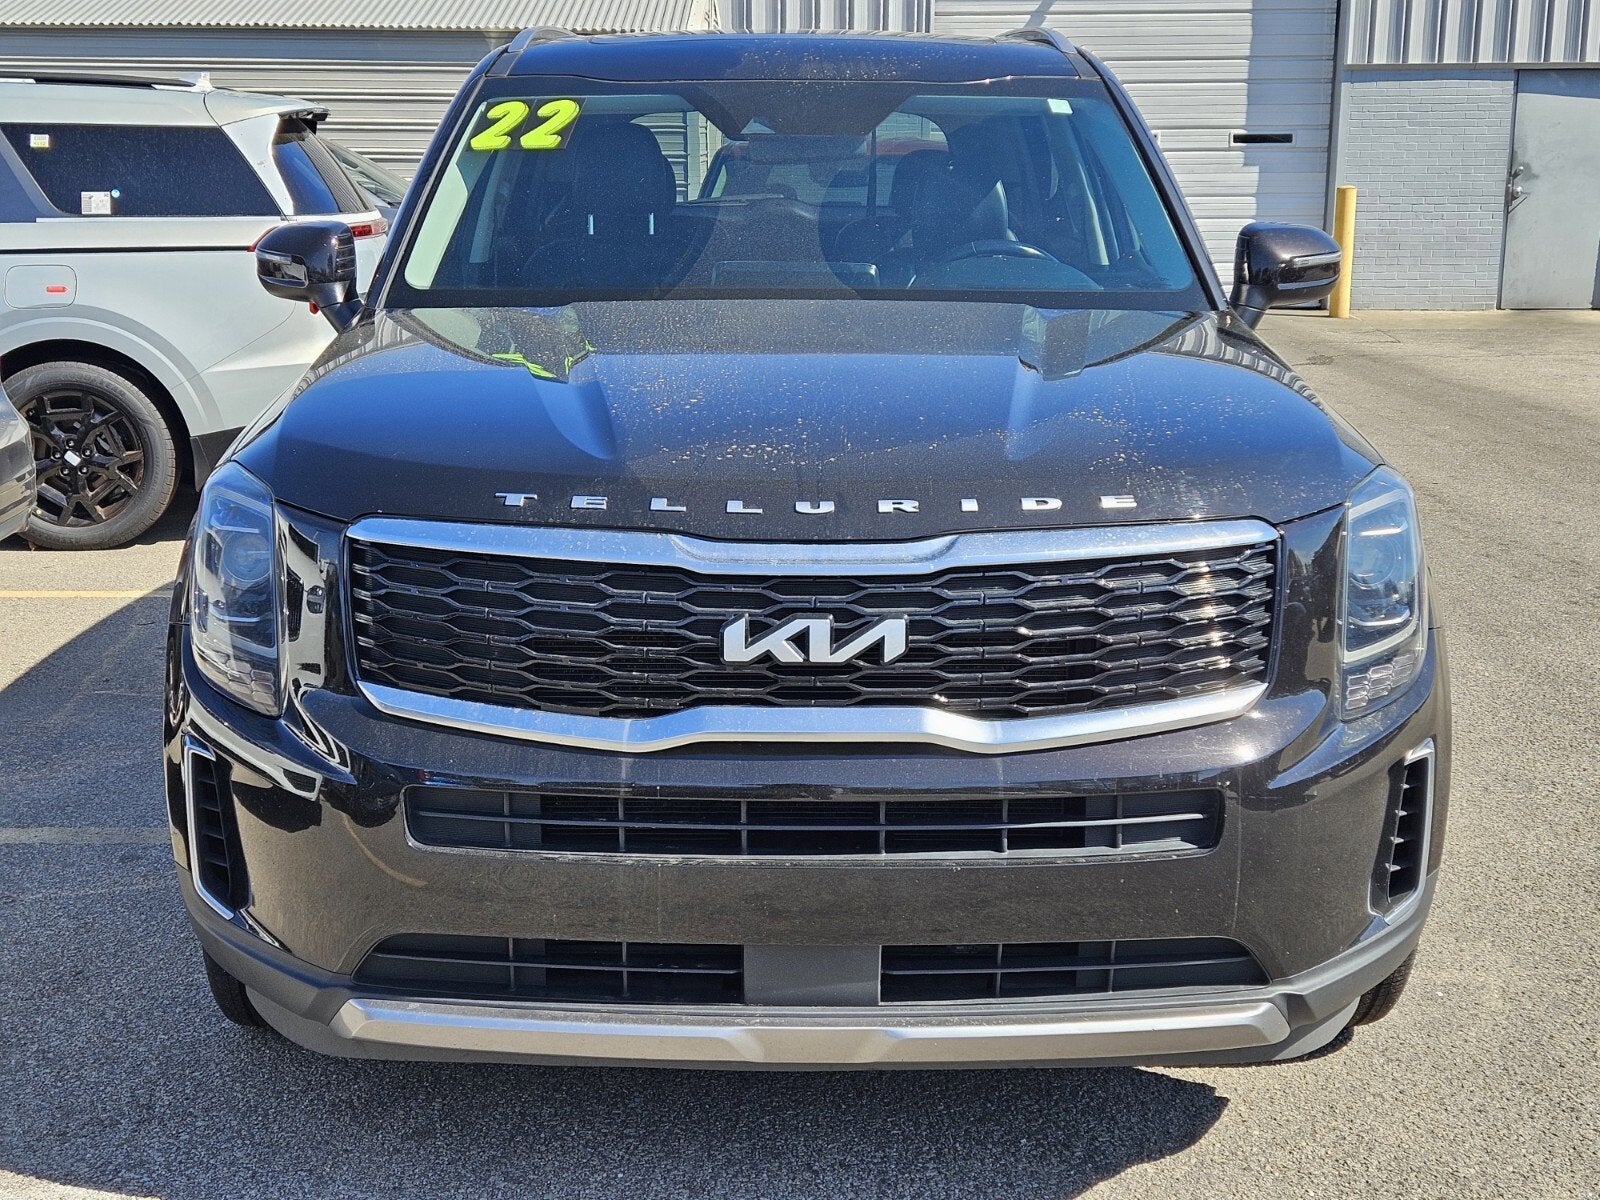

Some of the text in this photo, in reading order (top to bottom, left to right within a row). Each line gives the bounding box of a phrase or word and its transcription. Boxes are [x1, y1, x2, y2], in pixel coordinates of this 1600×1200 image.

[470, 99, 580, 151] 22
[494, 492, 1138, 515] TELLURIDE
[722, 614, 908, 664] KIA
